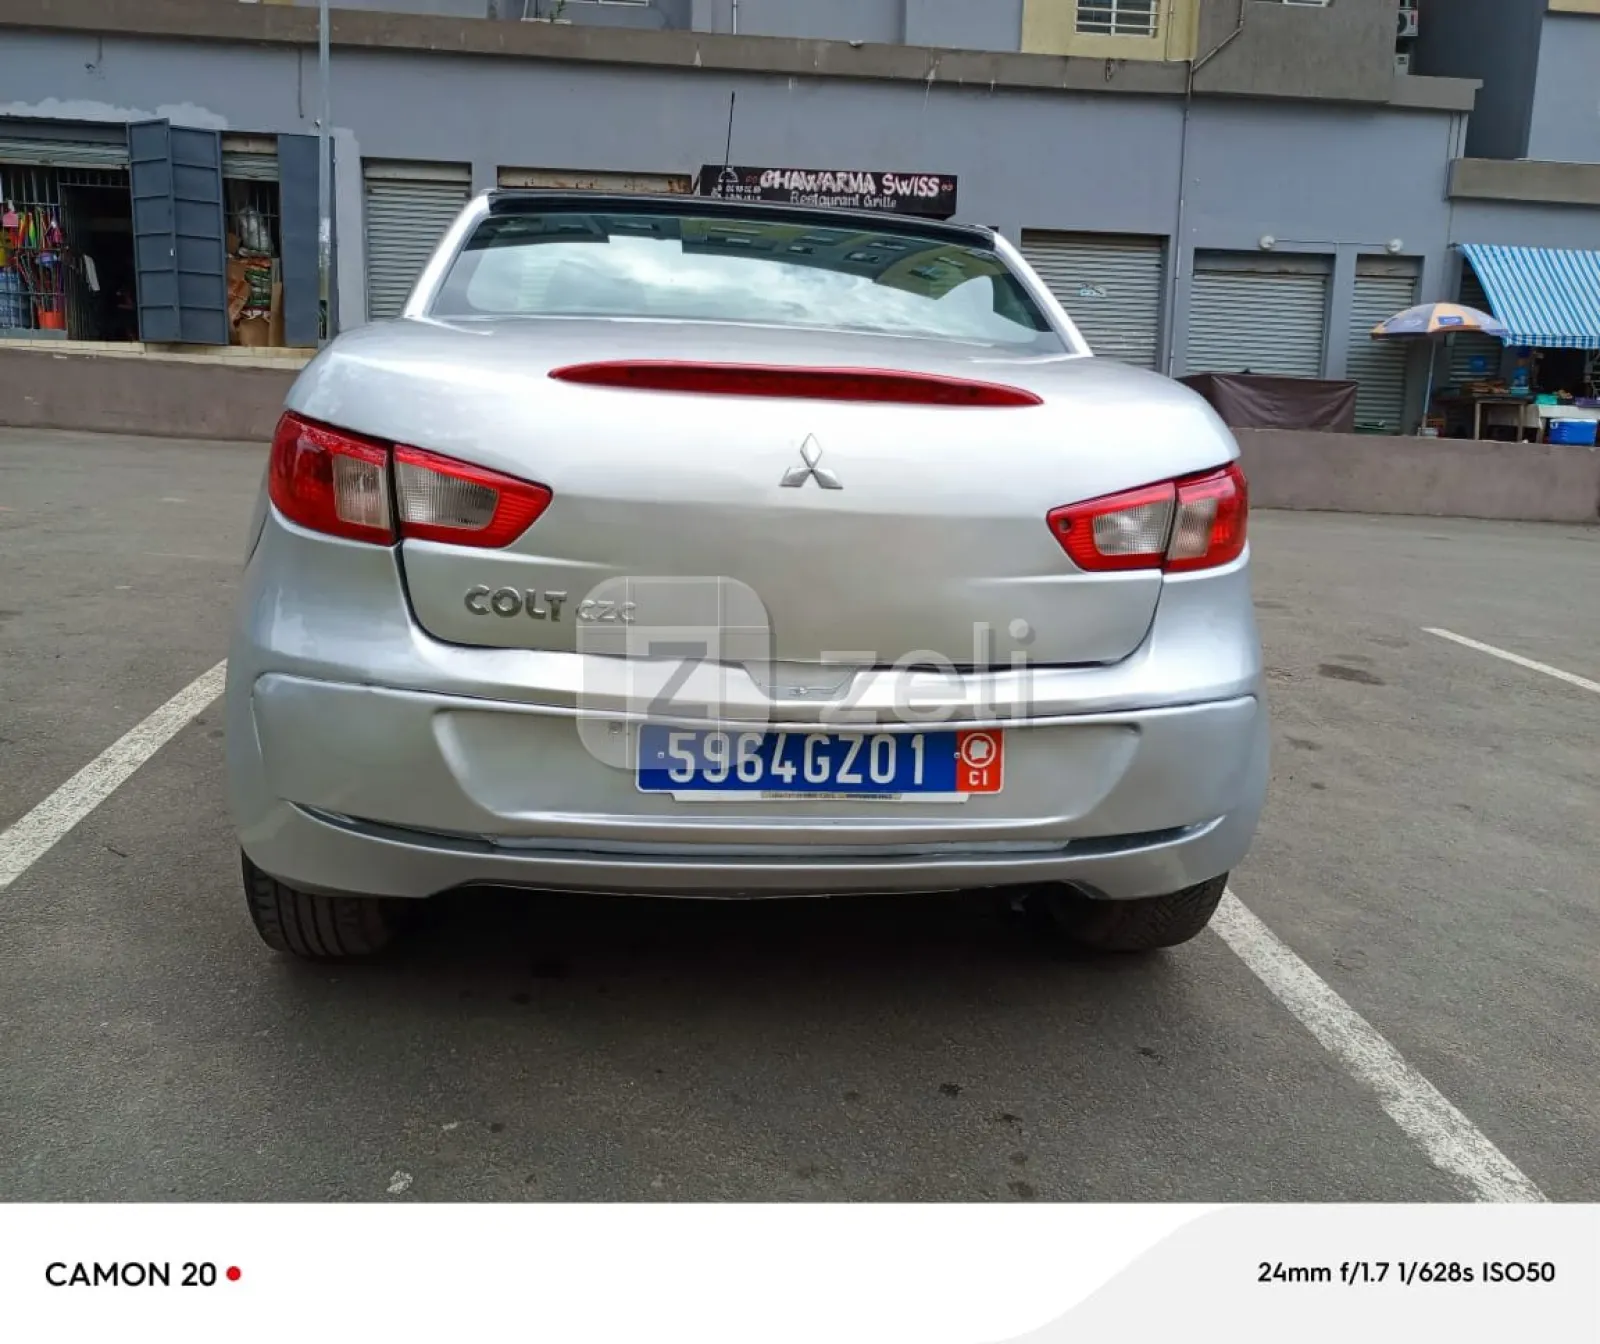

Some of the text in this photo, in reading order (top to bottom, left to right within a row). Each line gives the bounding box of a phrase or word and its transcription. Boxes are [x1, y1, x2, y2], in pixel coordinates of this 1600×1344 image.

[881, 174, 940, 197] SWISS
[790, 191, 897, 209] Restaurant Grille
[464, 584, 567, 622] COLT
[968, 770, 989, 787] CI
